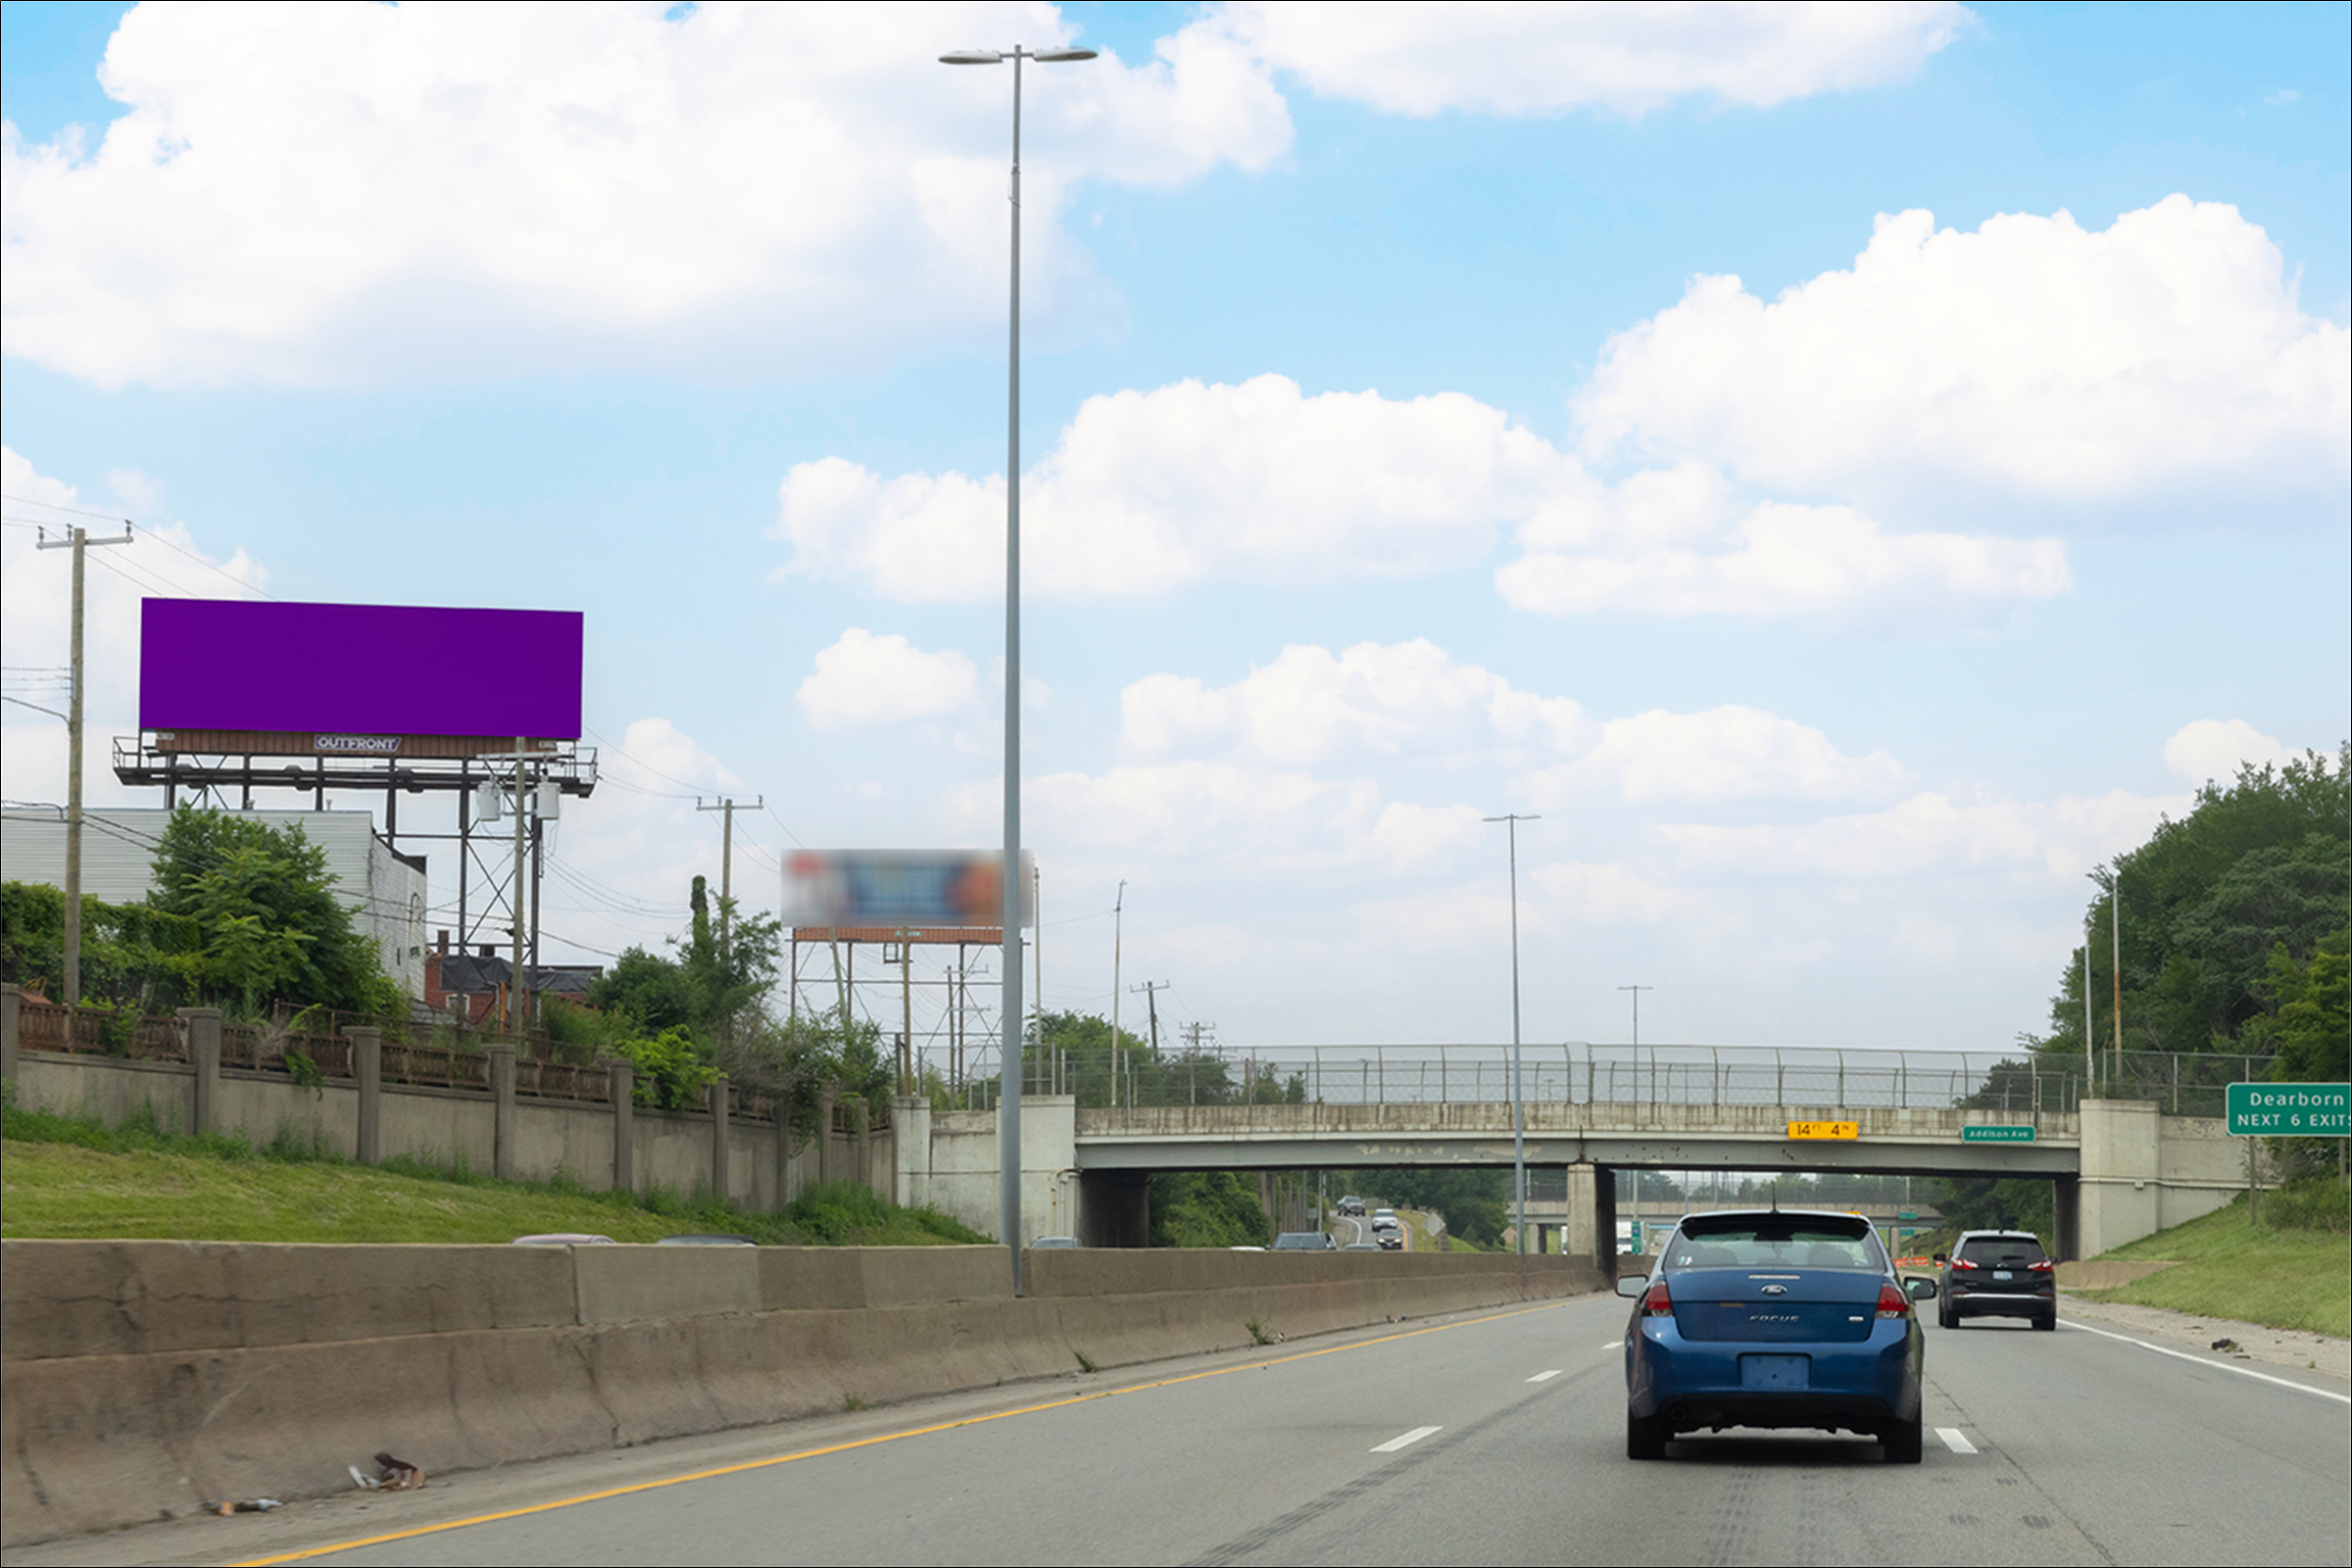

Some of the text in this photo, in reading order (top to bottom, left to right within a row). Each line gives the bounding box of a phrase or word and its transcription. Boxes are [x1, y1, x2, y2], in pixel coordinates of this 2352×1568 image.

[318, 737, 396, 751] OUTFRONT
[2250, 1092, 2344, 1106] Dearborn
[2237, 1113, 2280, 1126] NEXT
[2290, 1113, 2301, 1127] 6
